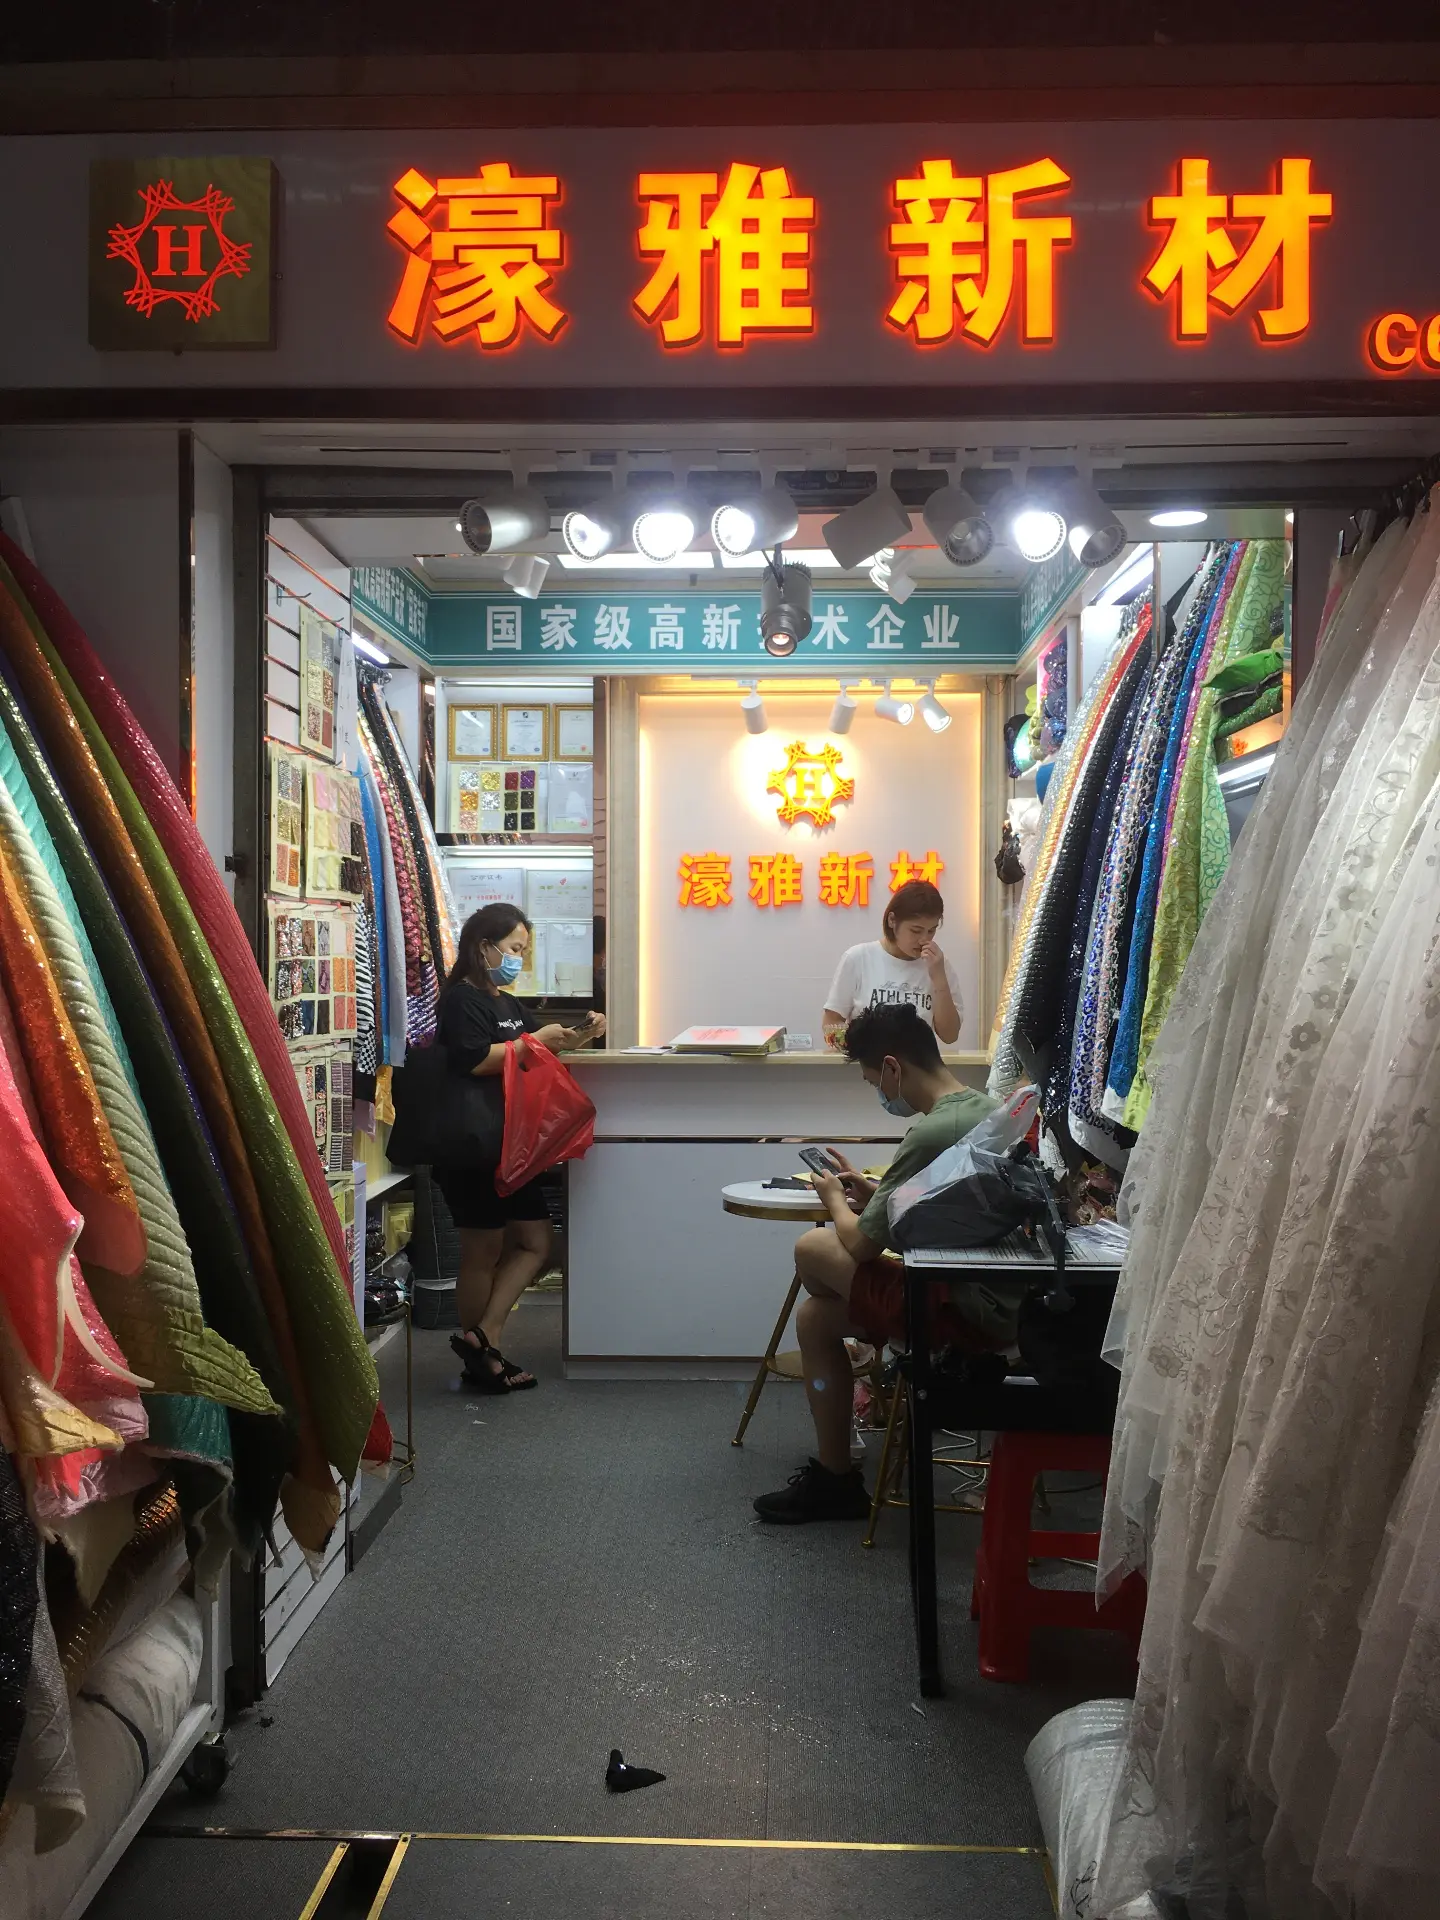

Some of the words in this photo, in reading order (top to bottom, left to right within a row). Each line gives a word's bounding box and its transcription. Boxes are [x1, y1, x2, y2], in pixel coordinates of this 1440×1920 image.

[151, 224, 209, 277] H
[388, 157, 1333, 348] 濠雅新材
[486, 604, 961, 652] 国家级高新术企业
[792, 767, 828, 808] H
[870, 988, 933, 1011] ATHLETIC
